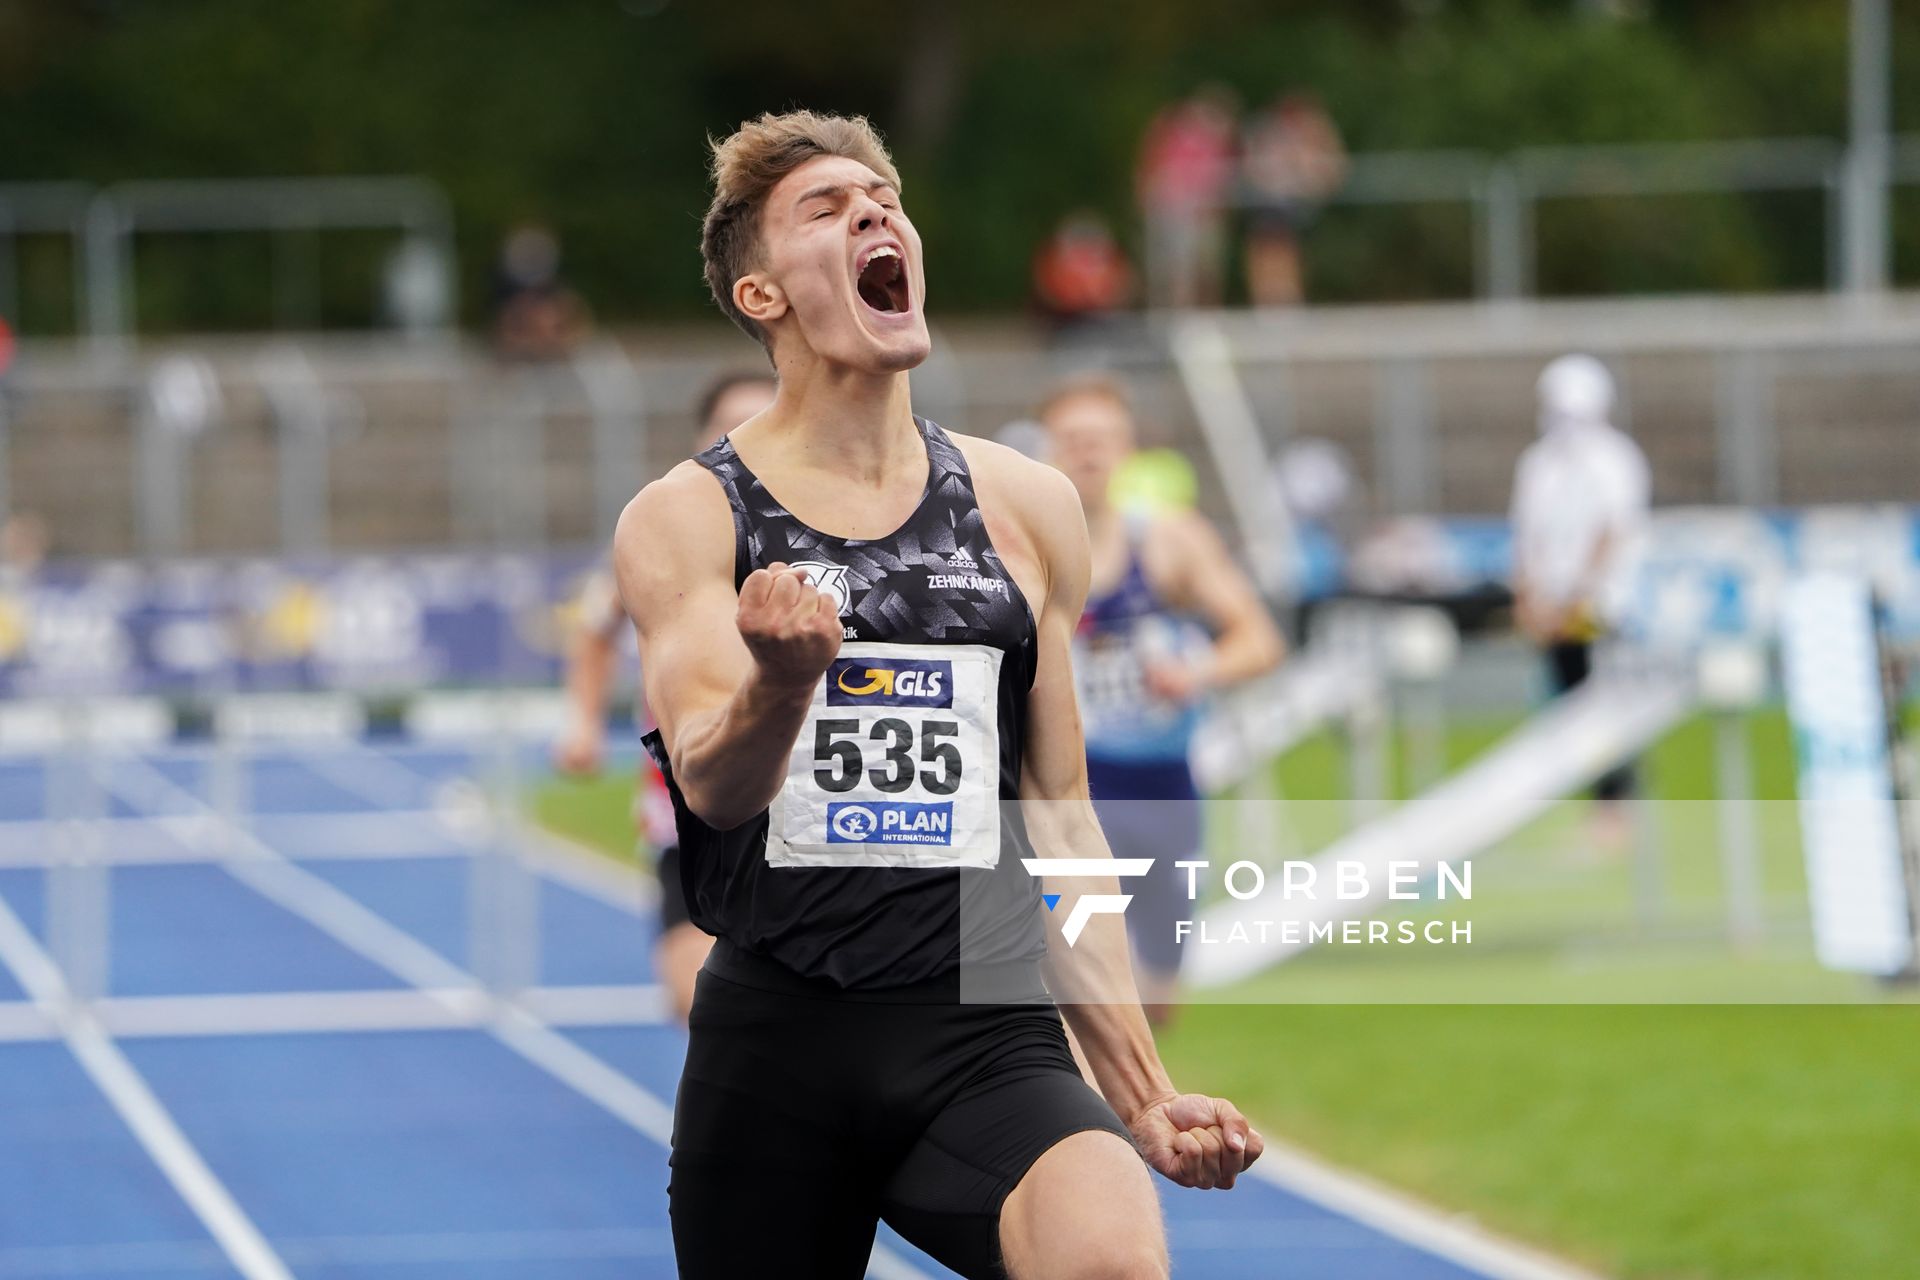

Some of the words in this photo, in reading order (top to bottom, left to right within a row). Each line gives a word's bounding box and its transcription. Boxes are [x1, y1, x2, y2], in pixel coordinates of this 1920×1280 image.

[947, 559, 979, 570] adidas
[926, 574, 1004, 593] ZEHNKAMPF
[842, 626, 858, 639] tik
[894, 669, 943, 697] GLS
[812, 717, 963, 796] 535
[882, 809, 948, 833] PLAN
[882, 833, 946, 843] INTERNATIONAL
